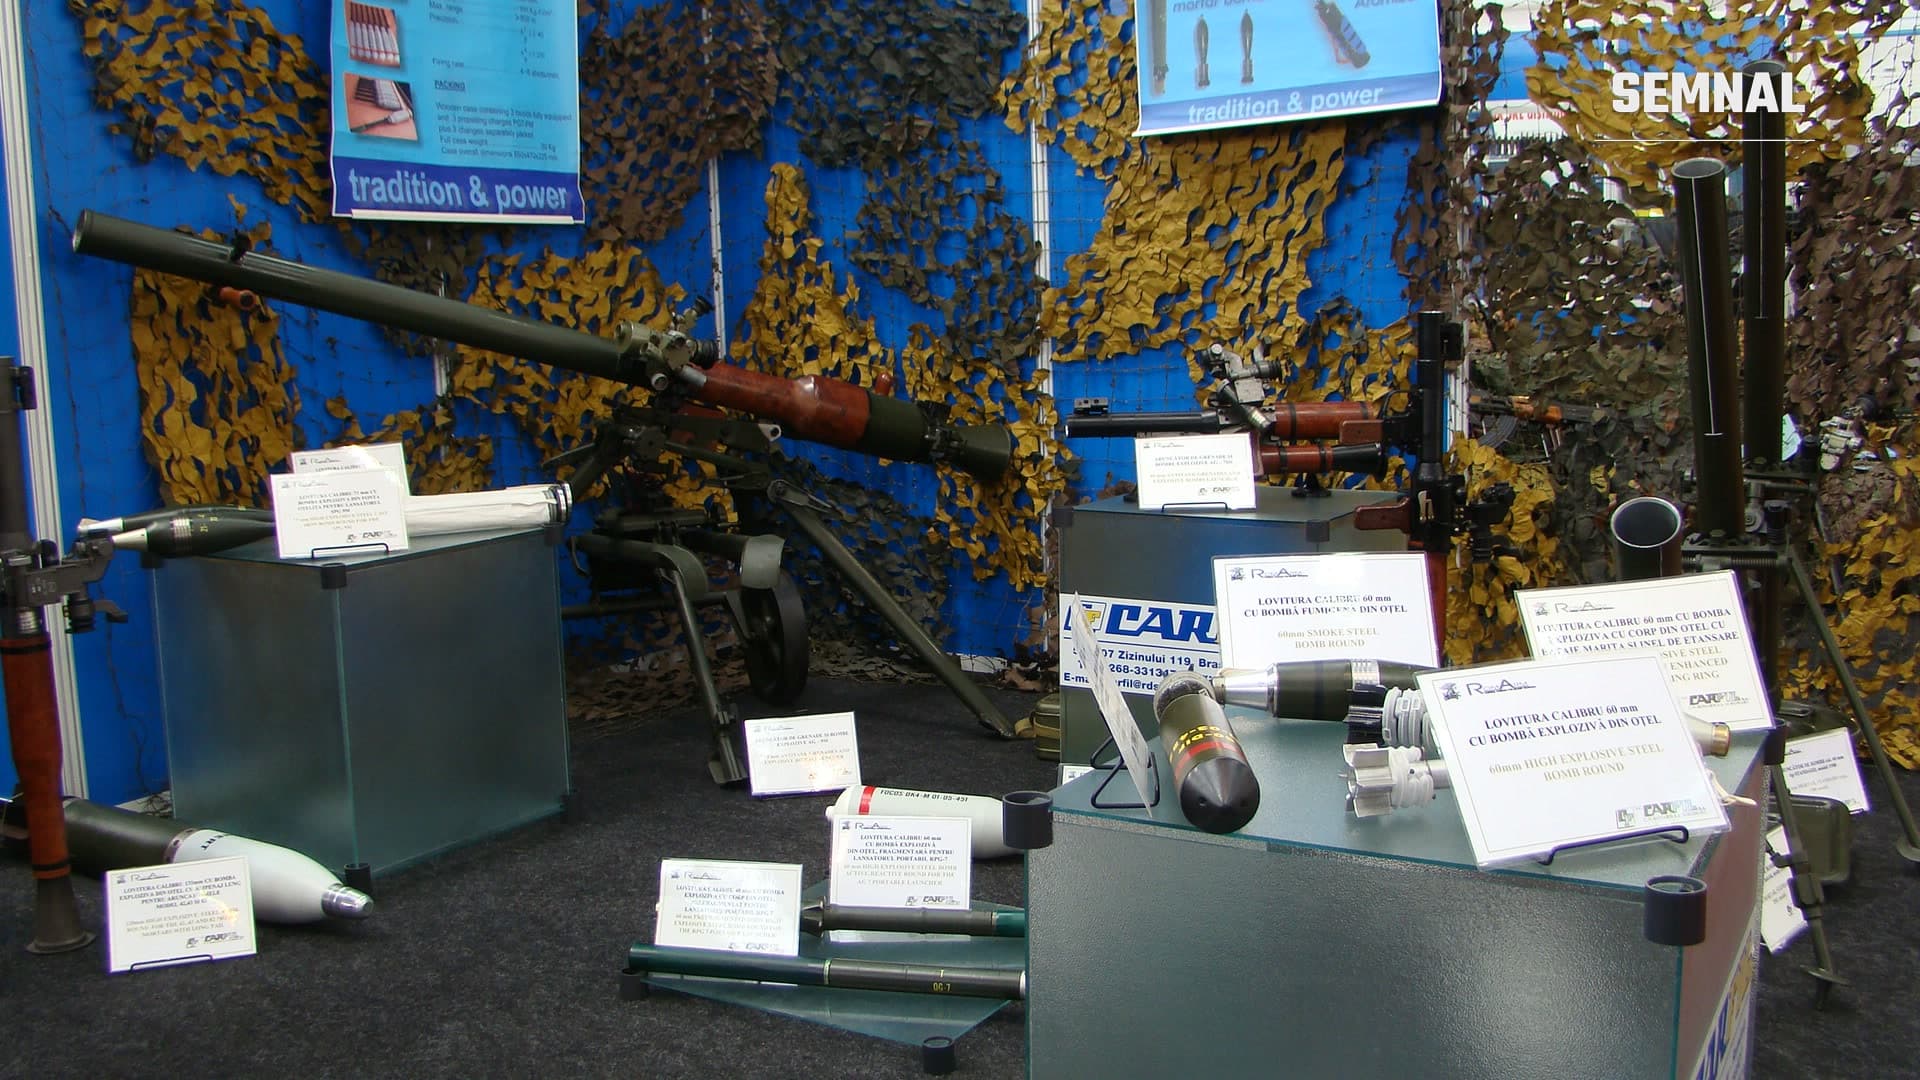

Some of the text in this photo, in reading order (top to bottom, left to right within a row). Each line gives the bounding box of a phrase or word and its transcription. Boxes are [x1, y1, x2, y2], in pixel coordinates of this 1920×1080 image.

[1188, 87, 1383, 123] tradition & power
[349, 168, 568, 214] tradition & power
[1244, 609, 1258, 617] CU
[1360, 605, 1377, 613] DIN
[1258, 597, 1312, 606] LOVITURA
[1106, 604, 1218, 644] CAR
[1594, 617, 1641, 628] CALIBRU
[1644, 616, 1653, 624] 60
[1676, 612, 1689, 620] CU
[1693, 608, 1731, 619] BOMBA
[1307, 628, 1344, 637] SMOKE
[1347, 627, 1379, 636] STEEL
[1611, 630, 1625, 639] CU
[1628, 628, 1657, 637] CORP
[1660, 626, 1678, 634] DIN
[1681, 623, 1710, 632] OTEL
[1711, 620, 1725, 629] CU
[1668, 637, 1681, 645] DE
[1684, 632, 1739, 644] ETANSARE
[1295, 639, 1365, 649] BOMB ROUND
[1660, 646, 1722, 658] SIVE STEEL
[1118, 651, 1166, 664] Zizinului
[1199, 658, 1218, 668] Bra
[1670, 658, 1728, 670] ENHANCED
[1064, 672, 1159, 691] E-ma rfil@rds
[1693, 671, 1719, 680] RING
[1484, 705, 1639, 730] LOVITURA CALIBRU 60 mm
[1469, 736, 1487, 747] CU
[1609, 716, 1629, 729] DIN
[1489, 743, 1664, 774] 60mm HIGH EXPLOSIVE STEEL
[1544, 762, 1624, 782] BOMB ROUND
